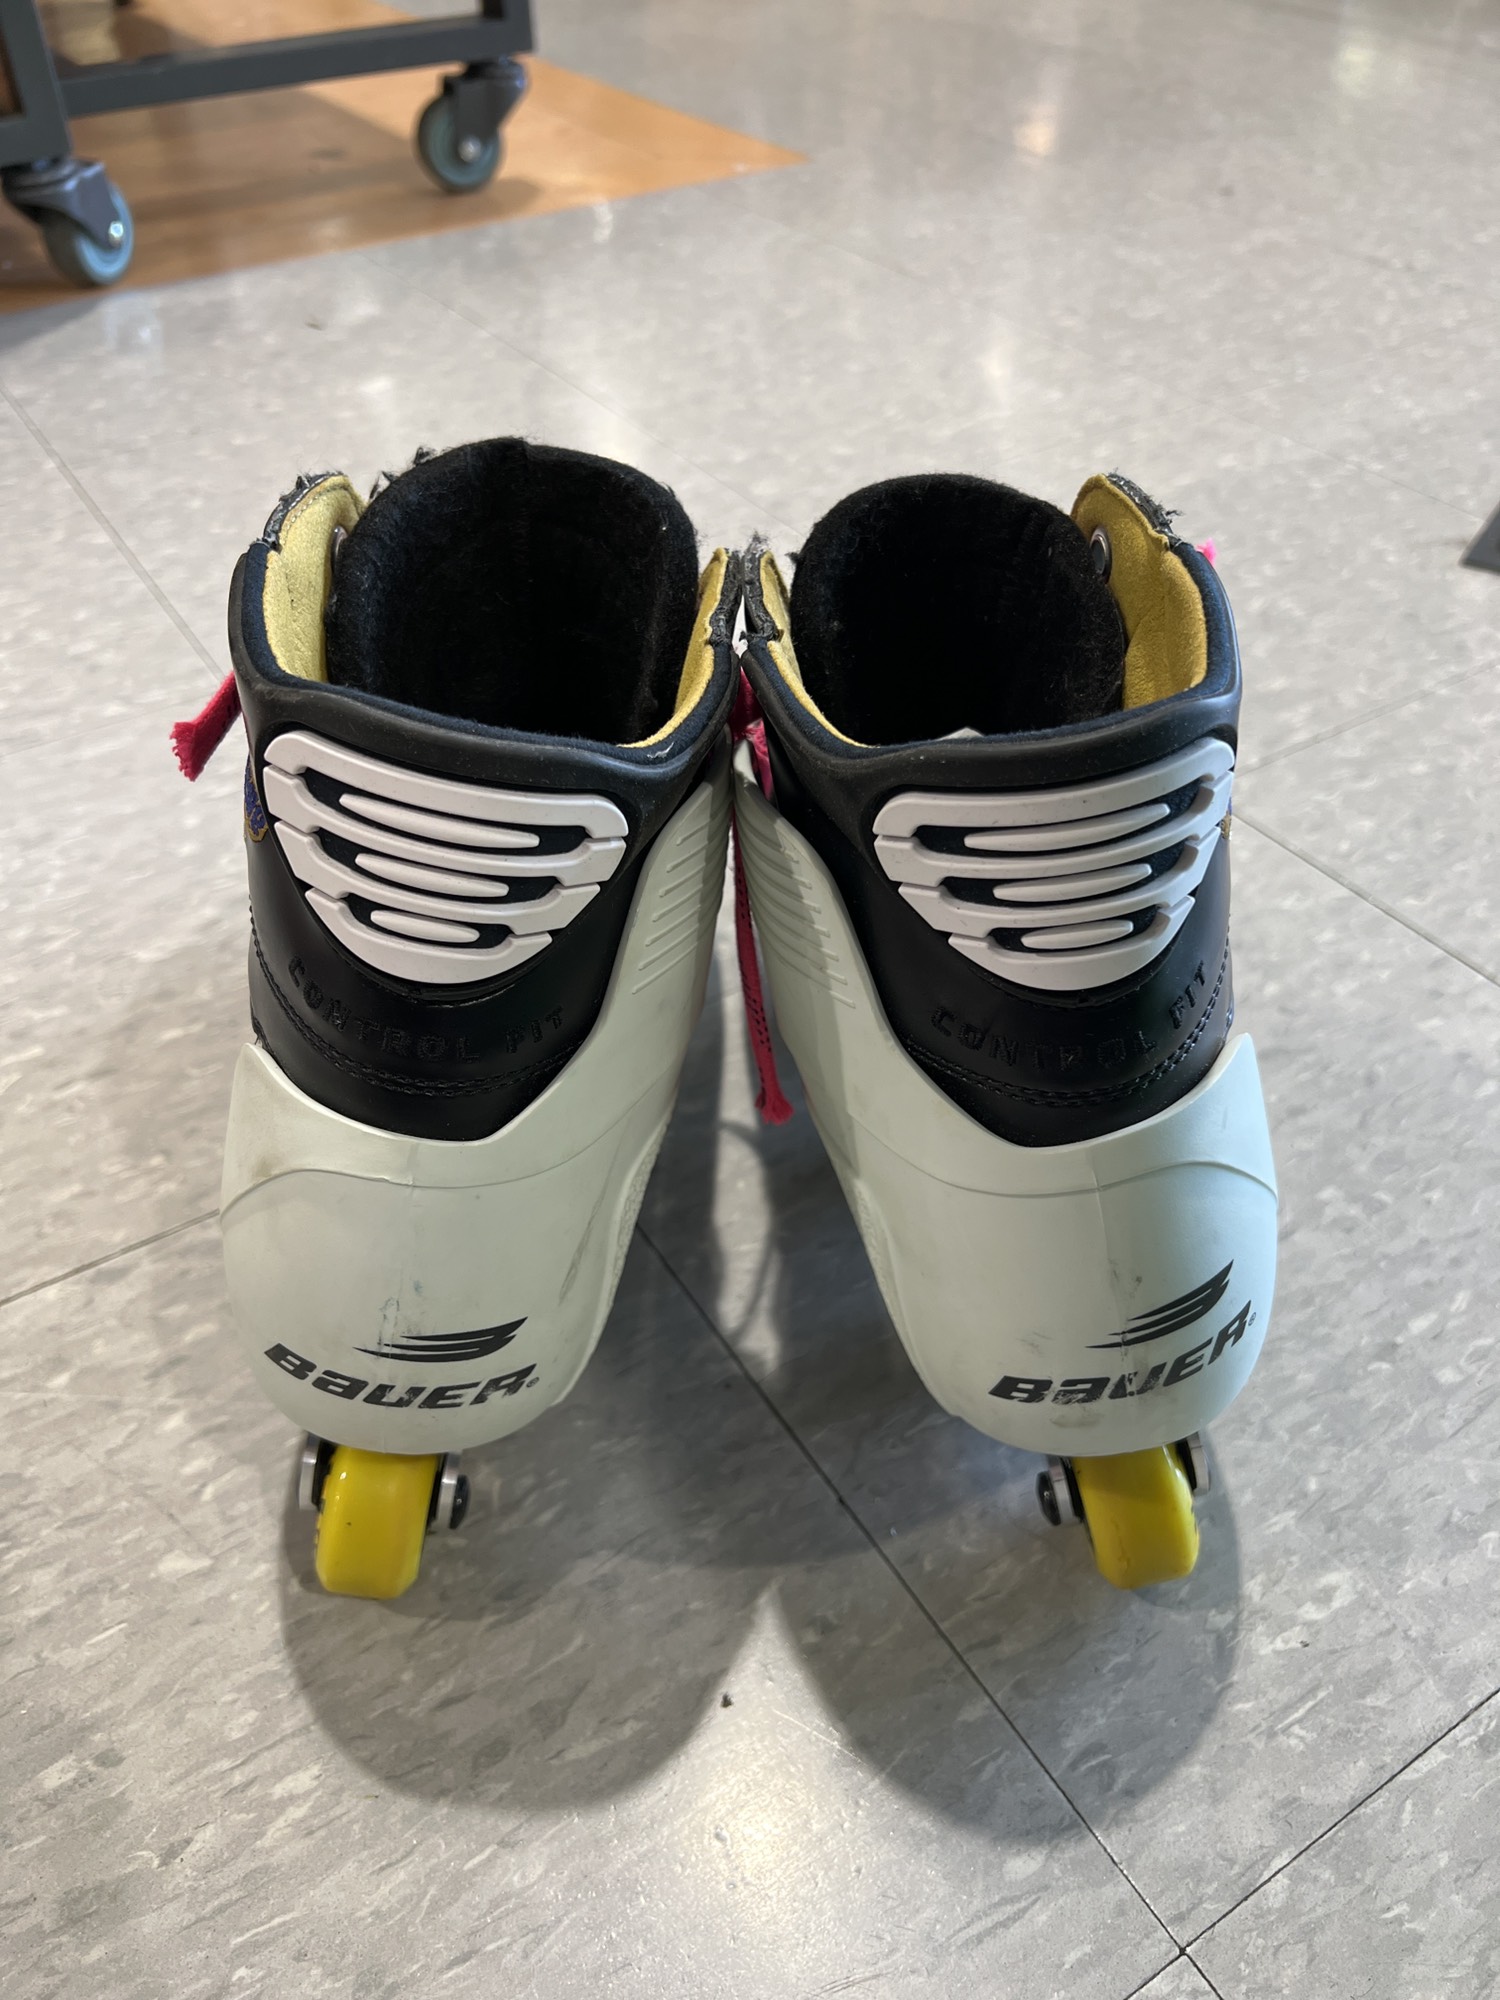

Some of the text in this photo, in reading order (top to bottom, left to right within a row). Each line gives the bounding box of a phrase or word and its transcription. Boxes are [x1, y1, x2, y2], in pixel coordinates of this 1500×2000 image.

[288, 956, 564, 1063] CONTROL FIT
[931, 960, 1206, 1070] CONTROL FIT
